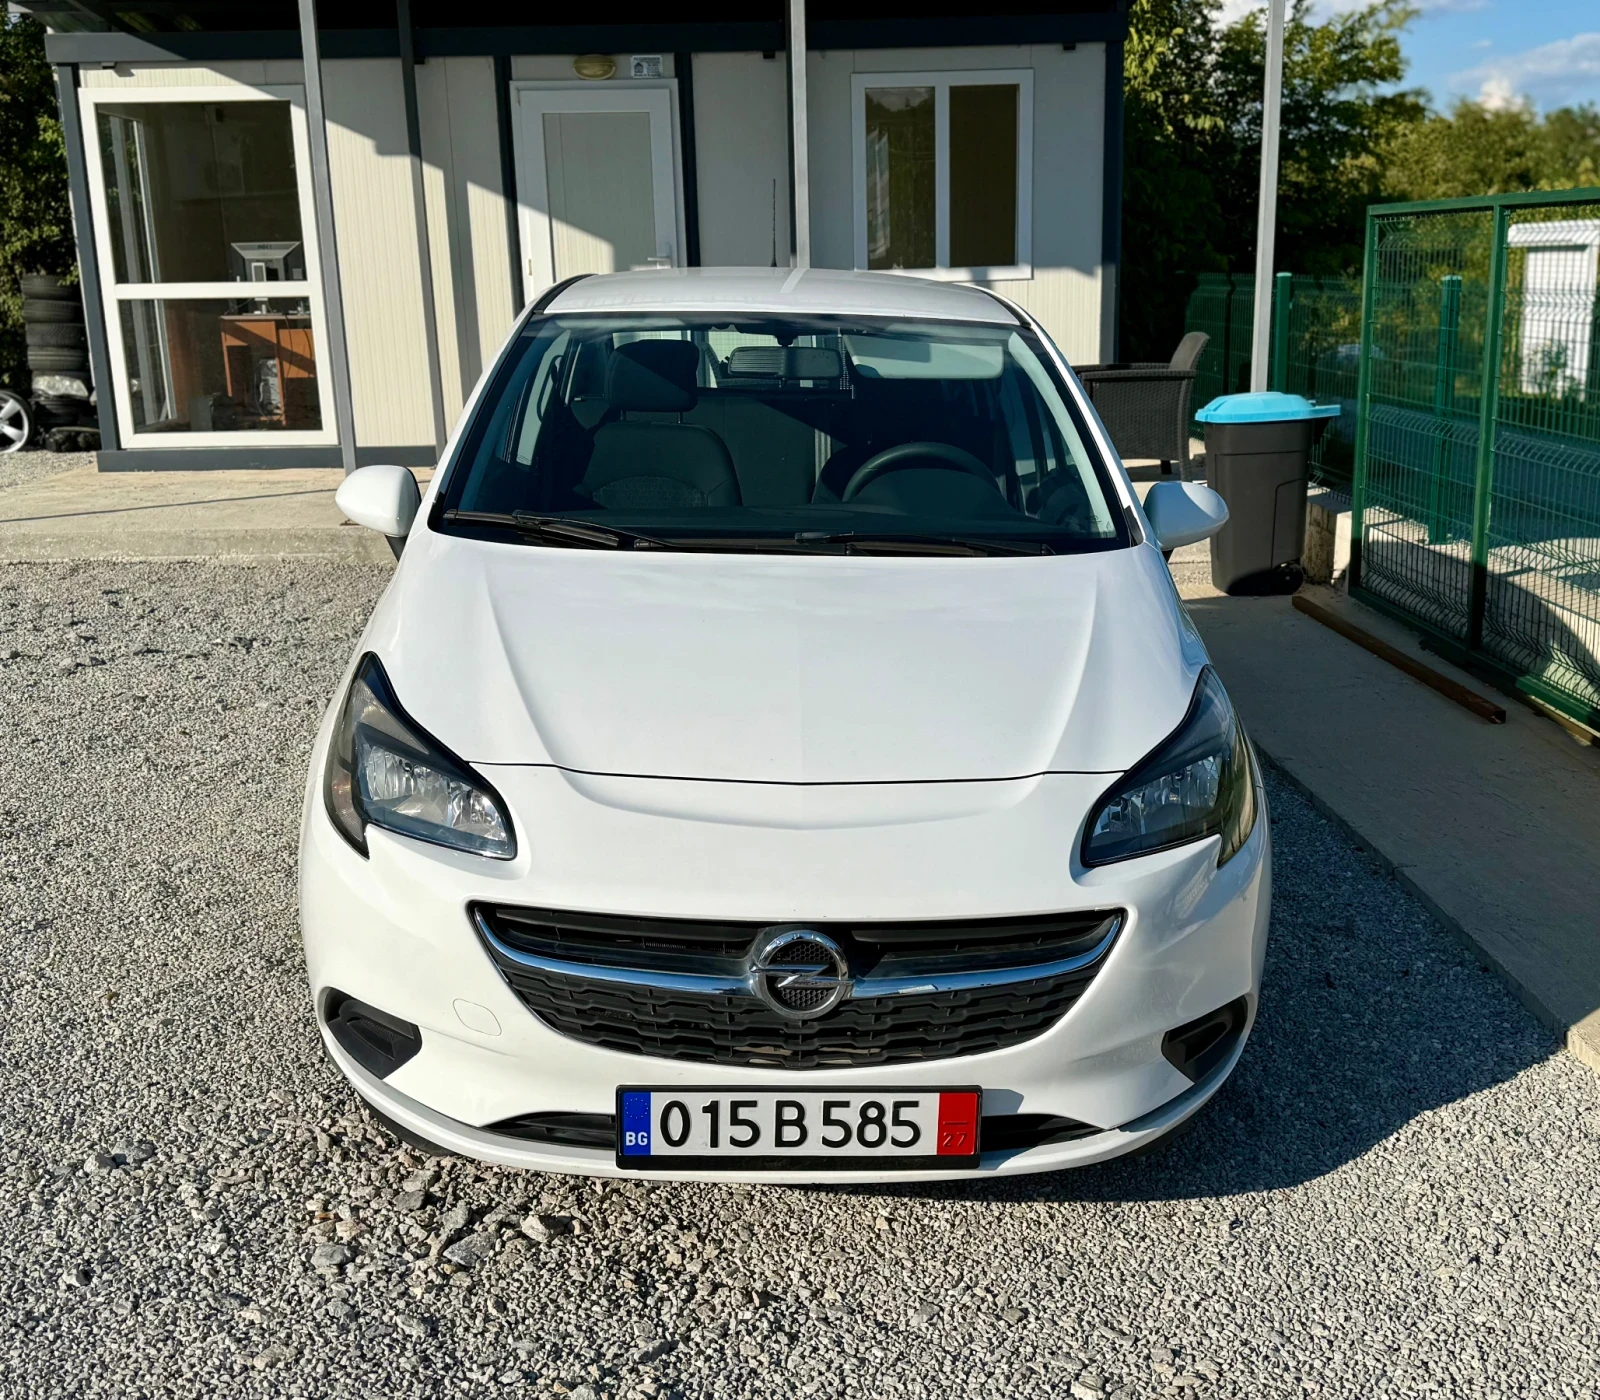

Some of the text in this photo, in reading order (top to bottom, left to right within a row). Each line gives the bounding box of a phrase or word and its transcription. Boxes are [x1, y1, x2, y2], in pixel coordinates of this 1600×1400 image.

[660, 1099, 921, 1148] 015 B 585
[625, 1131, 649, 1147] BG
[942, 1131, 968, 1148] 27
